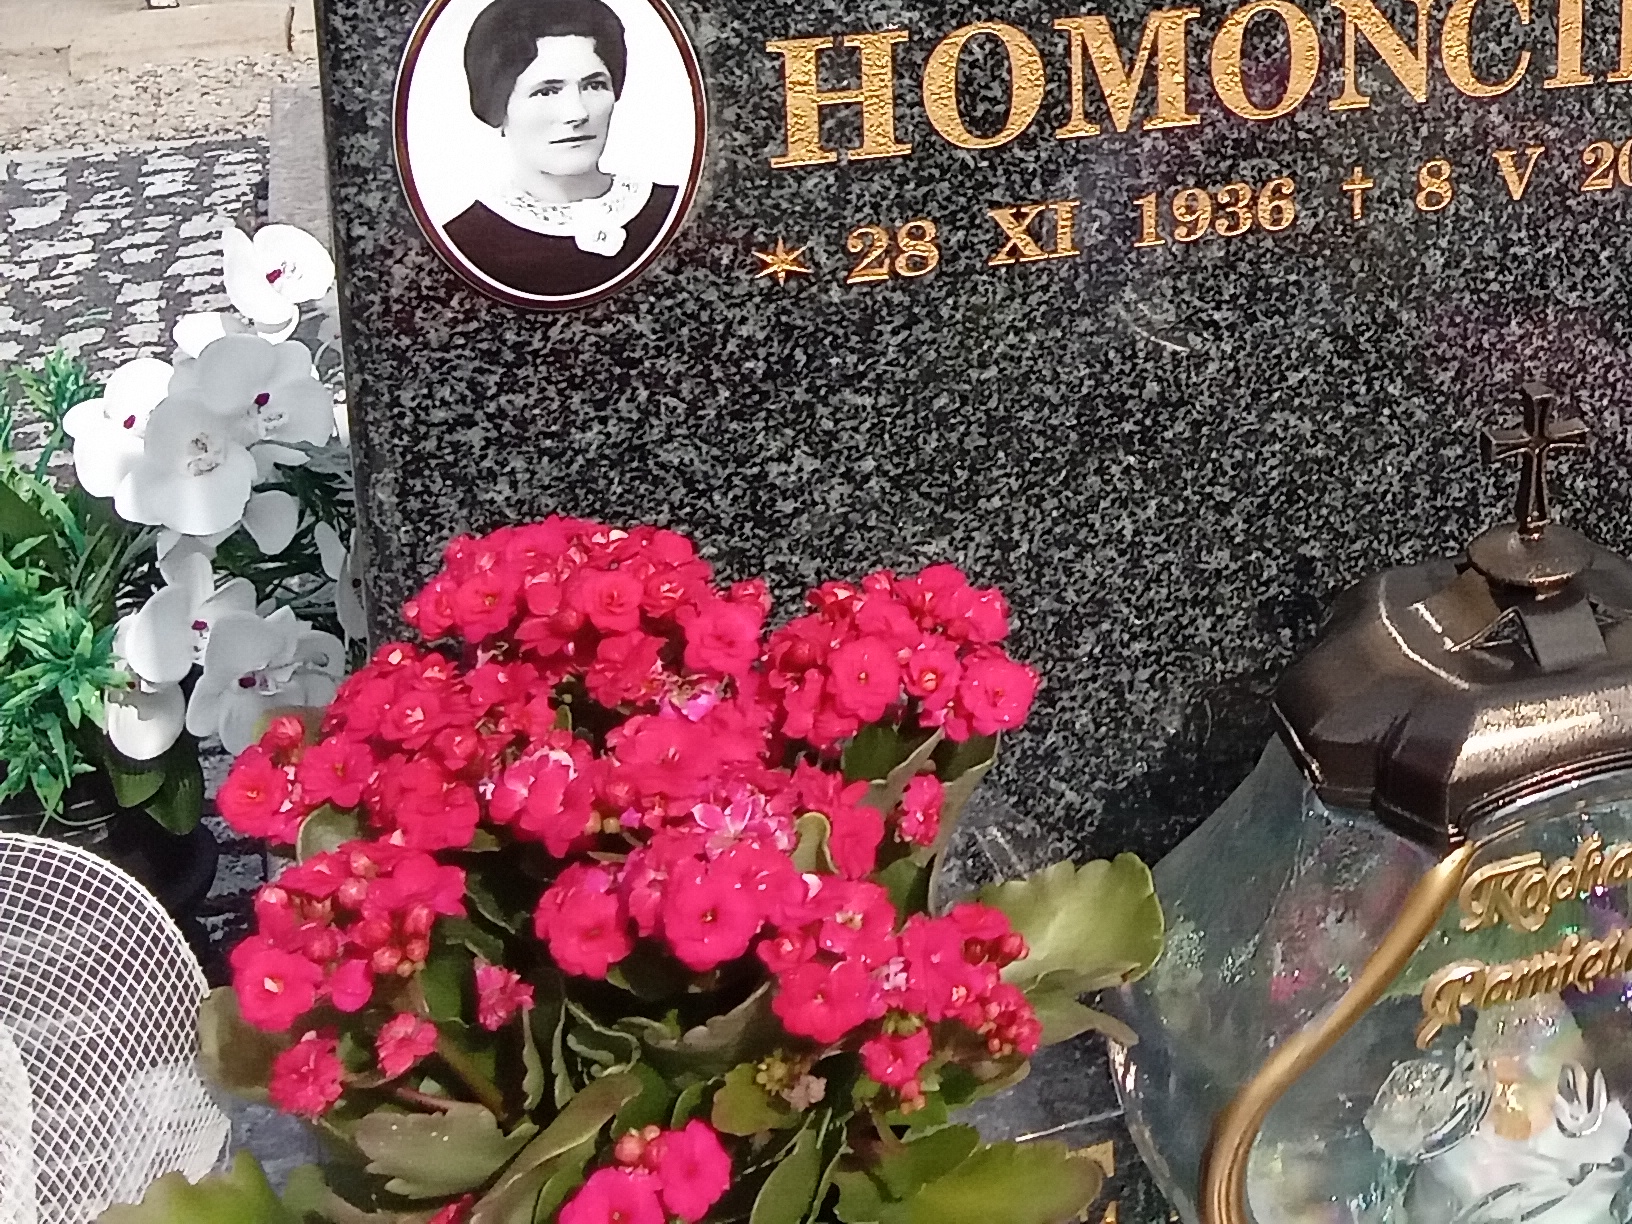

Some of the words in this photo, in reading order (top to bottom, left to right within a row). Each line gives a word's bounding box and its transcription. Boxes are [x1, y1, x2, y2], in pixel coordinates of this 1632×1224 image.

[845, 217, 940, 285] 28
[986, 199, 1082, 267] XI
[1132, 175, 1297, 249] 1936
[1415, 157, 1454, 212] 8
[1492, 145, 1546, 201] V
